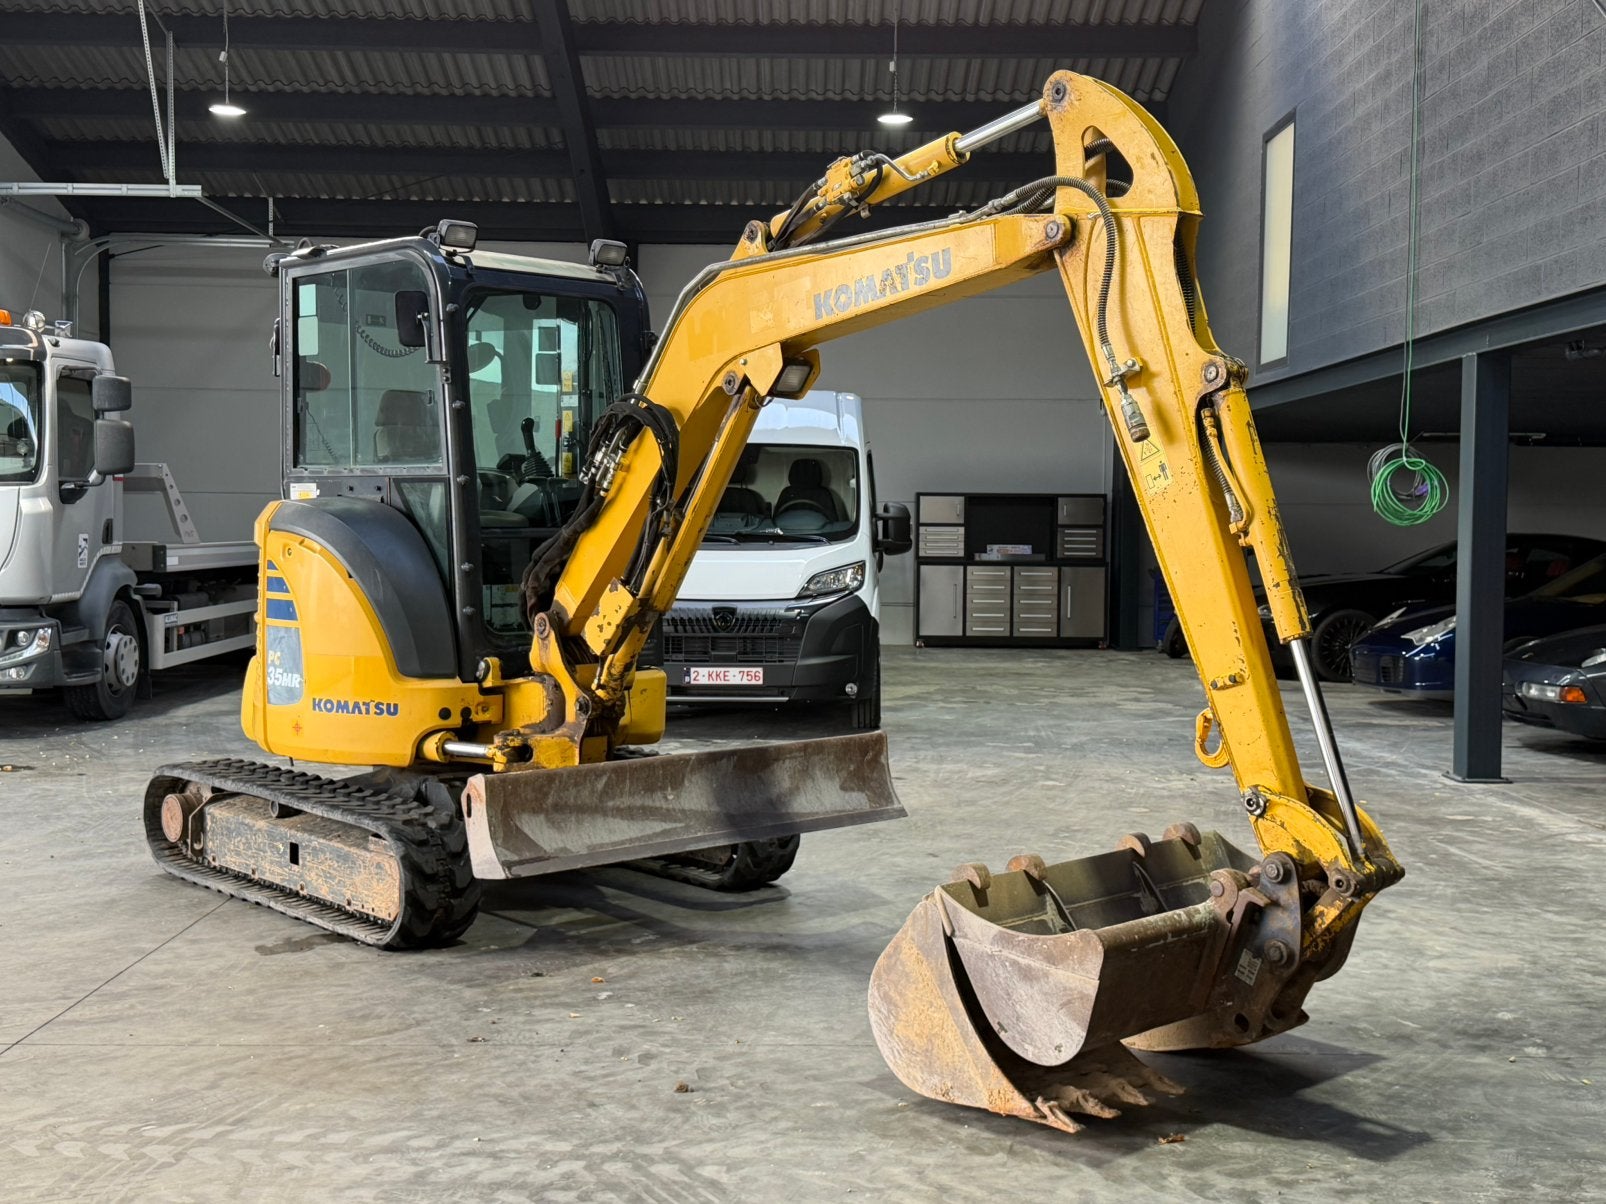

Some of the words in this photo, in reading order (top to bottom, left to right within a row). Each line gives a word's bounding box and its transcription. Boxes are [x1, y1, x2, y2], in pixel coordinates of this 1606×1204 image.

[813, 247, 953, 321] KOMATSU
[268, 650, 281, 665] PC
[267, 666, 301, 688] 35MR
[312, 697, 399, 716] KOMATSU
